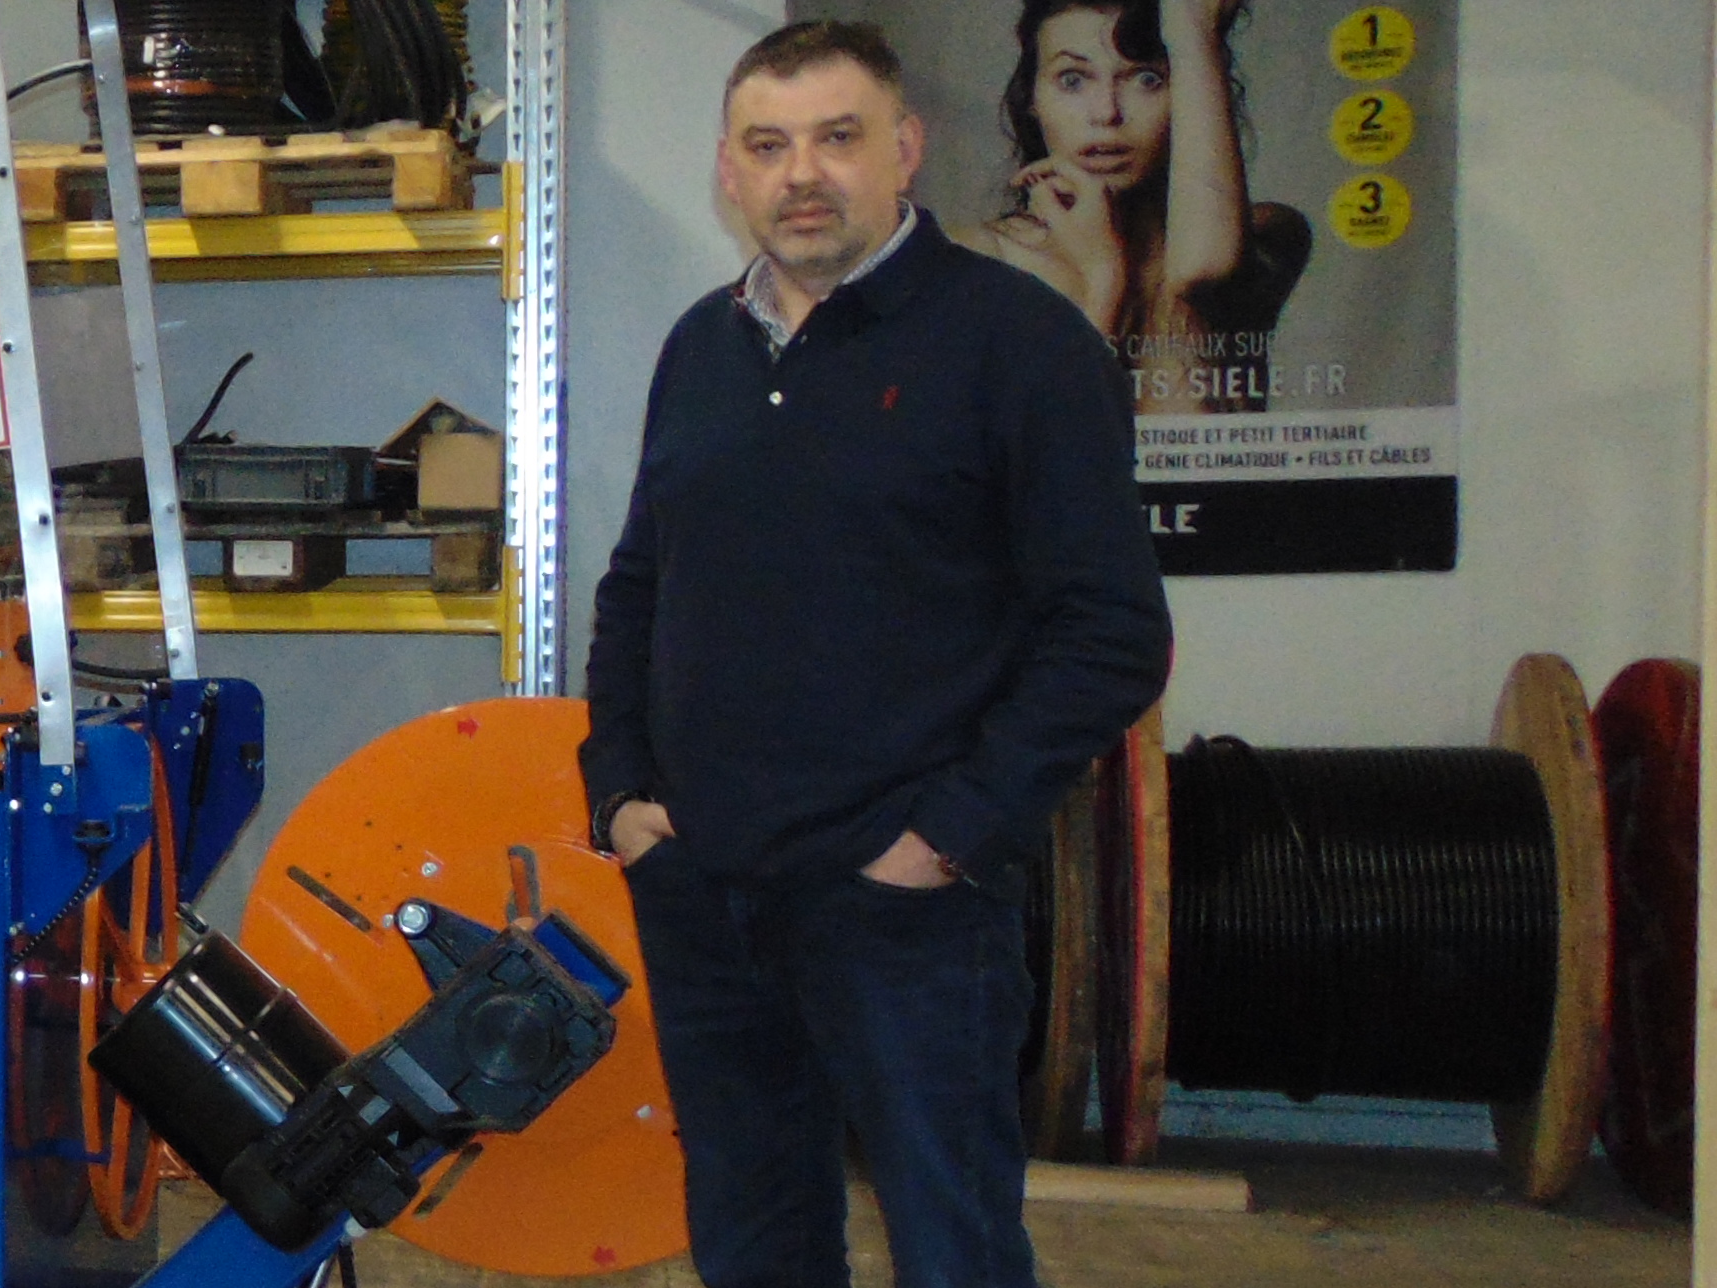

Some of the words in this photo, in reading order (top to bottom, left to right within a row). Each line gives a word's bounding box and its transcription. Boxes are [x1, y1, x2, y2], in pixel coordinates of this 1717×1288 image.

[1363, 14, 1379, 46] 1
[1359, 98, 1383, 131] 2
[1359, 181, 1383, 214] 3
[1129, 364, 1346, 400] TS.SIELE.FR
[1135, 428, 1199, 445] STIQUE
[1204, 427, 1222, 444] ET
[1229, 426, 1274, 443] PETIT
[1282, 424, 1368, 443] TERTIAIRE
[1195, 451, 1289, 468] CLIMATIQUE
[1309, 450, 1342, 466] FILS
[1347, 449, 1364, 465] ET
